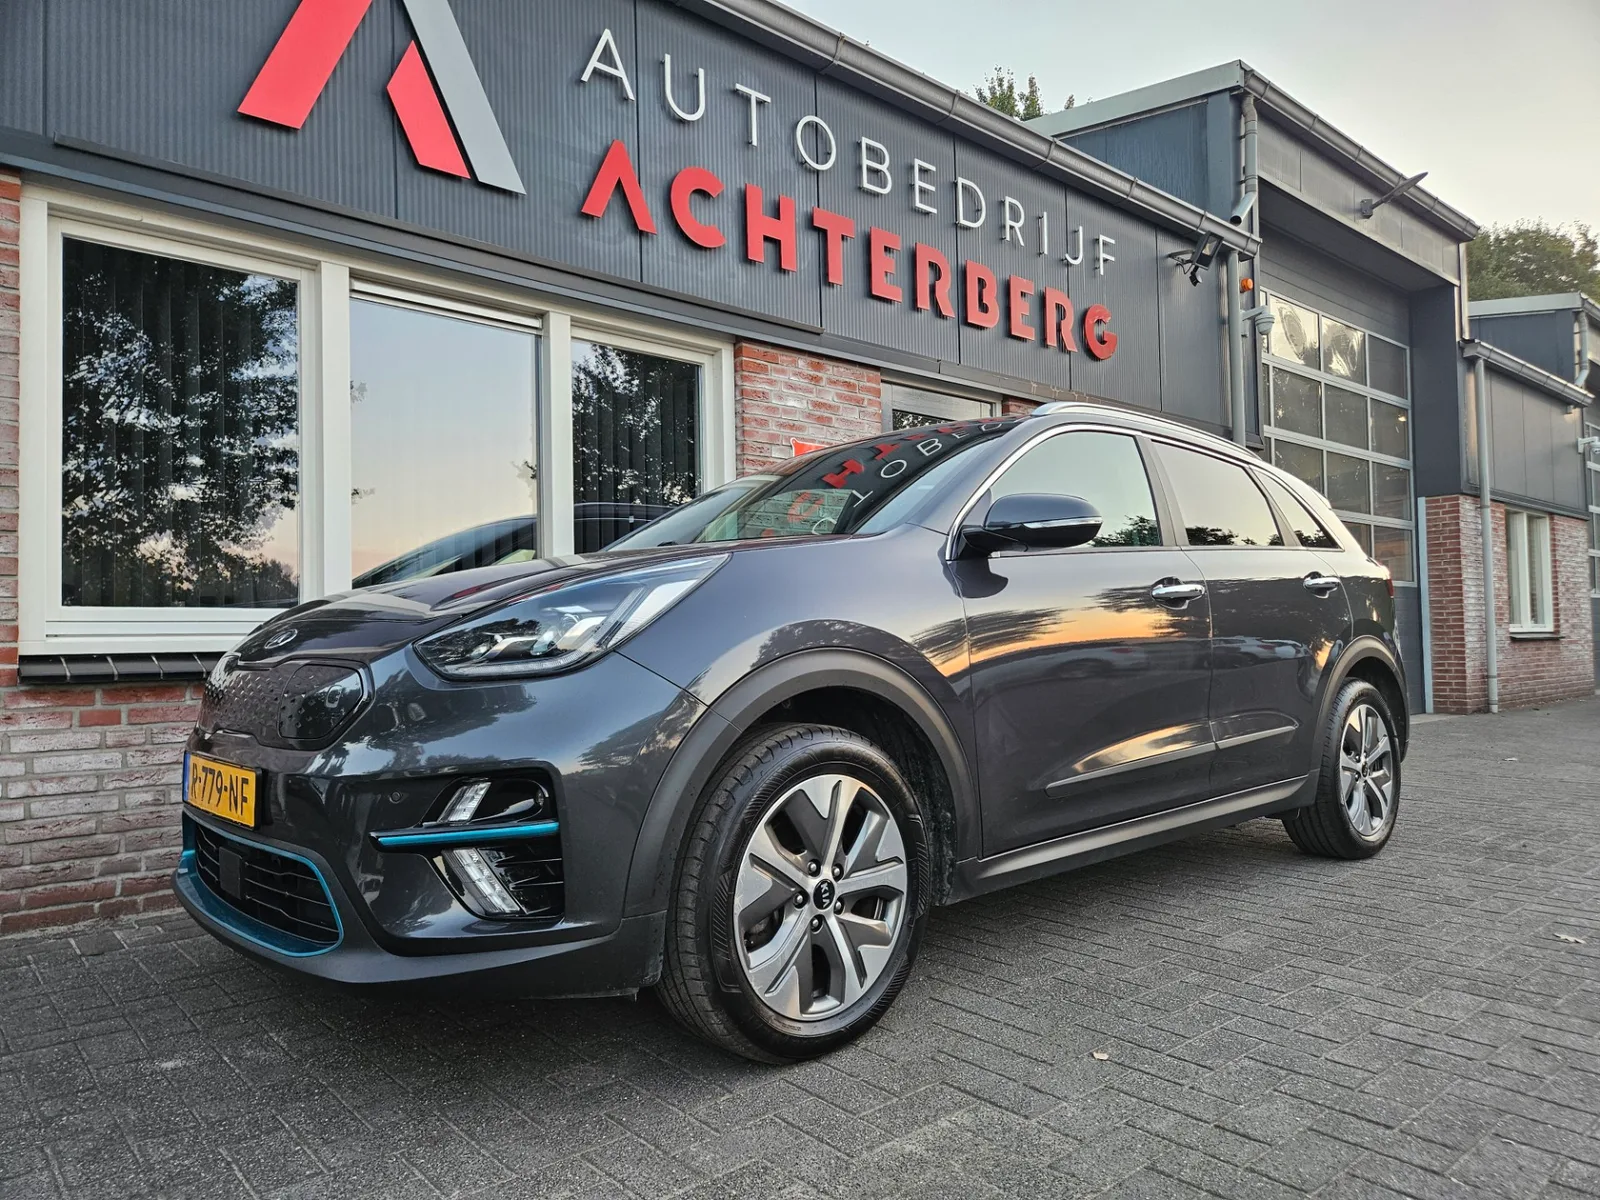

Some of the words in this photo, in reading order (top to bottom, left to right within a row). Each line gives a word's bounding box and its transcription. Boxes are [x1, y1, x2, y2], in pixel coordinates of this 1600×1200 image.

[580, 28, 1116, 275] AUTOBEDRIJF
[581, 139, 1118, 360] ACHTERBERG
[191, 762, 249, 816] R-779-NF
